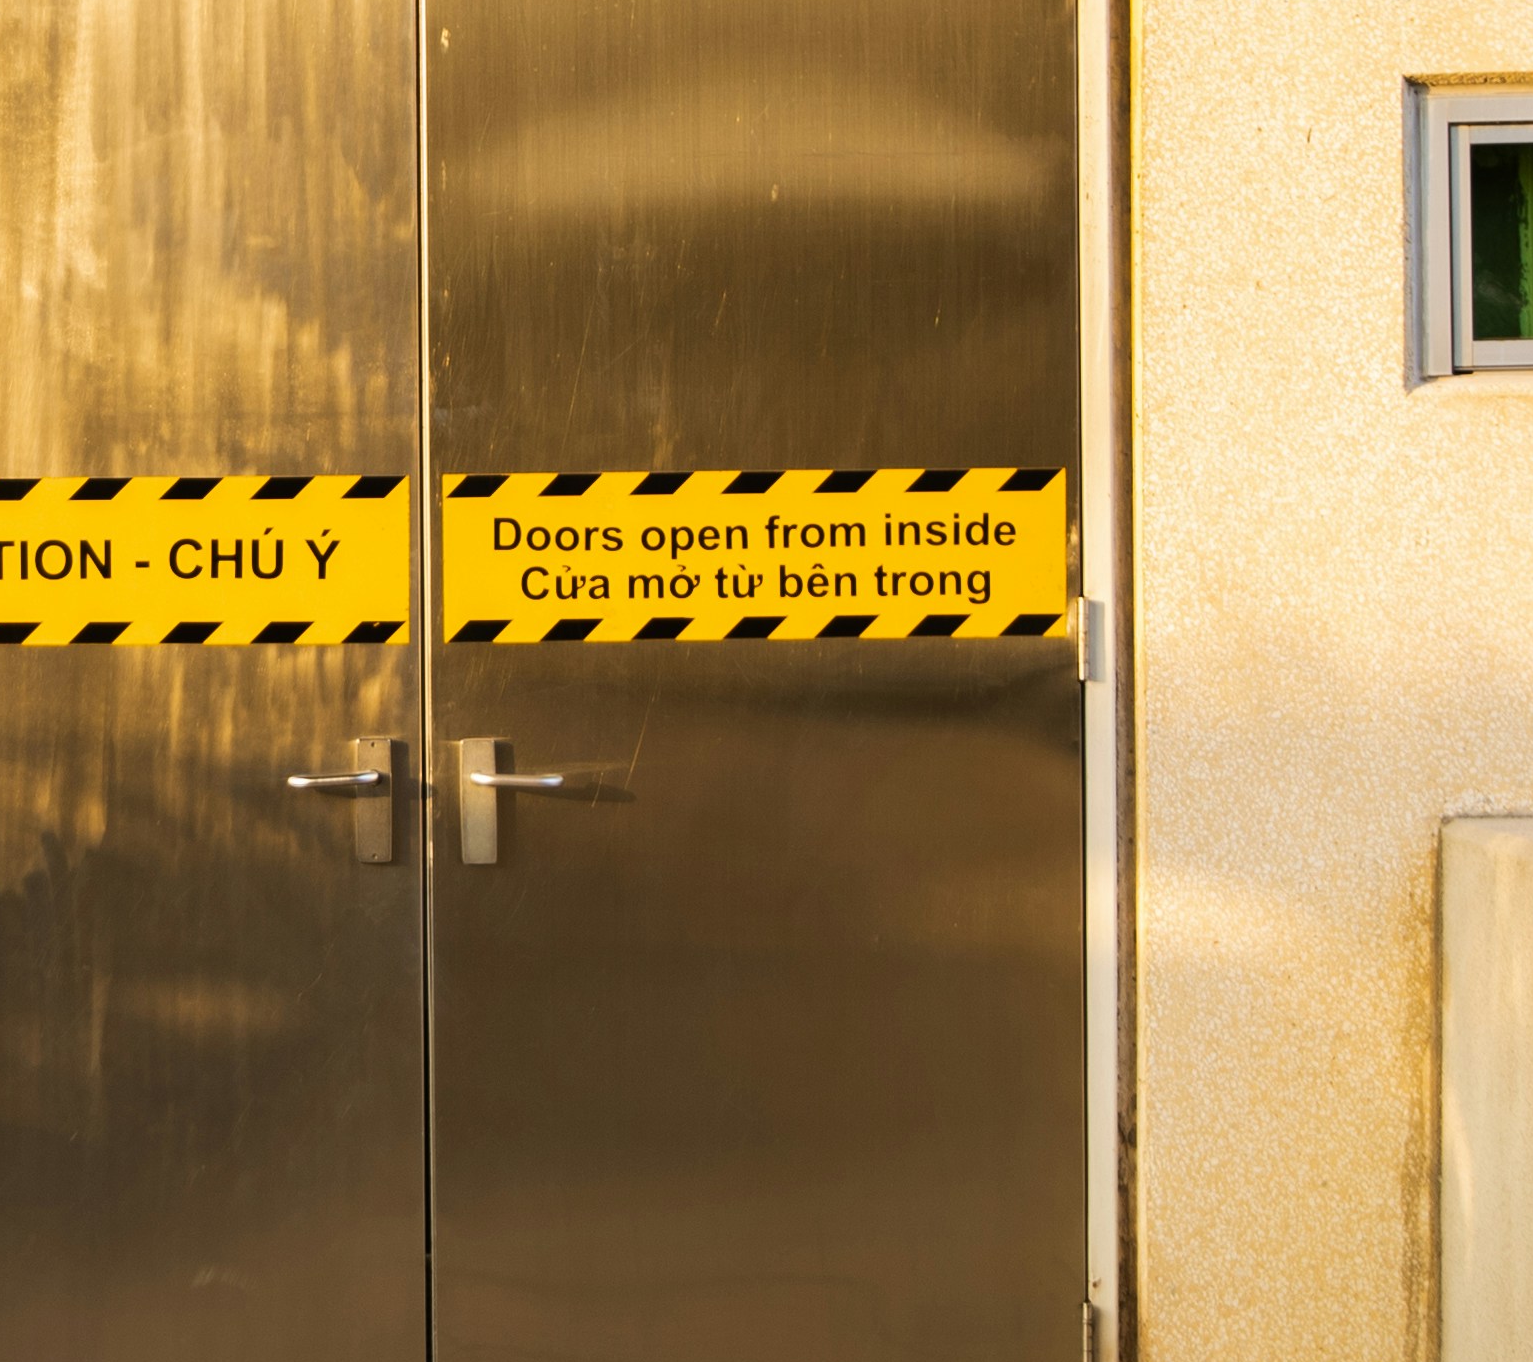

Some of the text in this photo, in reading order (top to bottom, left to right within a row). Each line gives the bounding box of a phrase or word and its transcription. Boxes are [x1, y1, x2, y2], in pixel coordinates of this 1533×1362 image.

[169, 527, 284, 580] CHÚ
[305, 528, 340, 580] Ý
[493, 512, 1017, 560] Doors open from inside
[521, 563, 992, 606] Cửa mở từ bên trong
